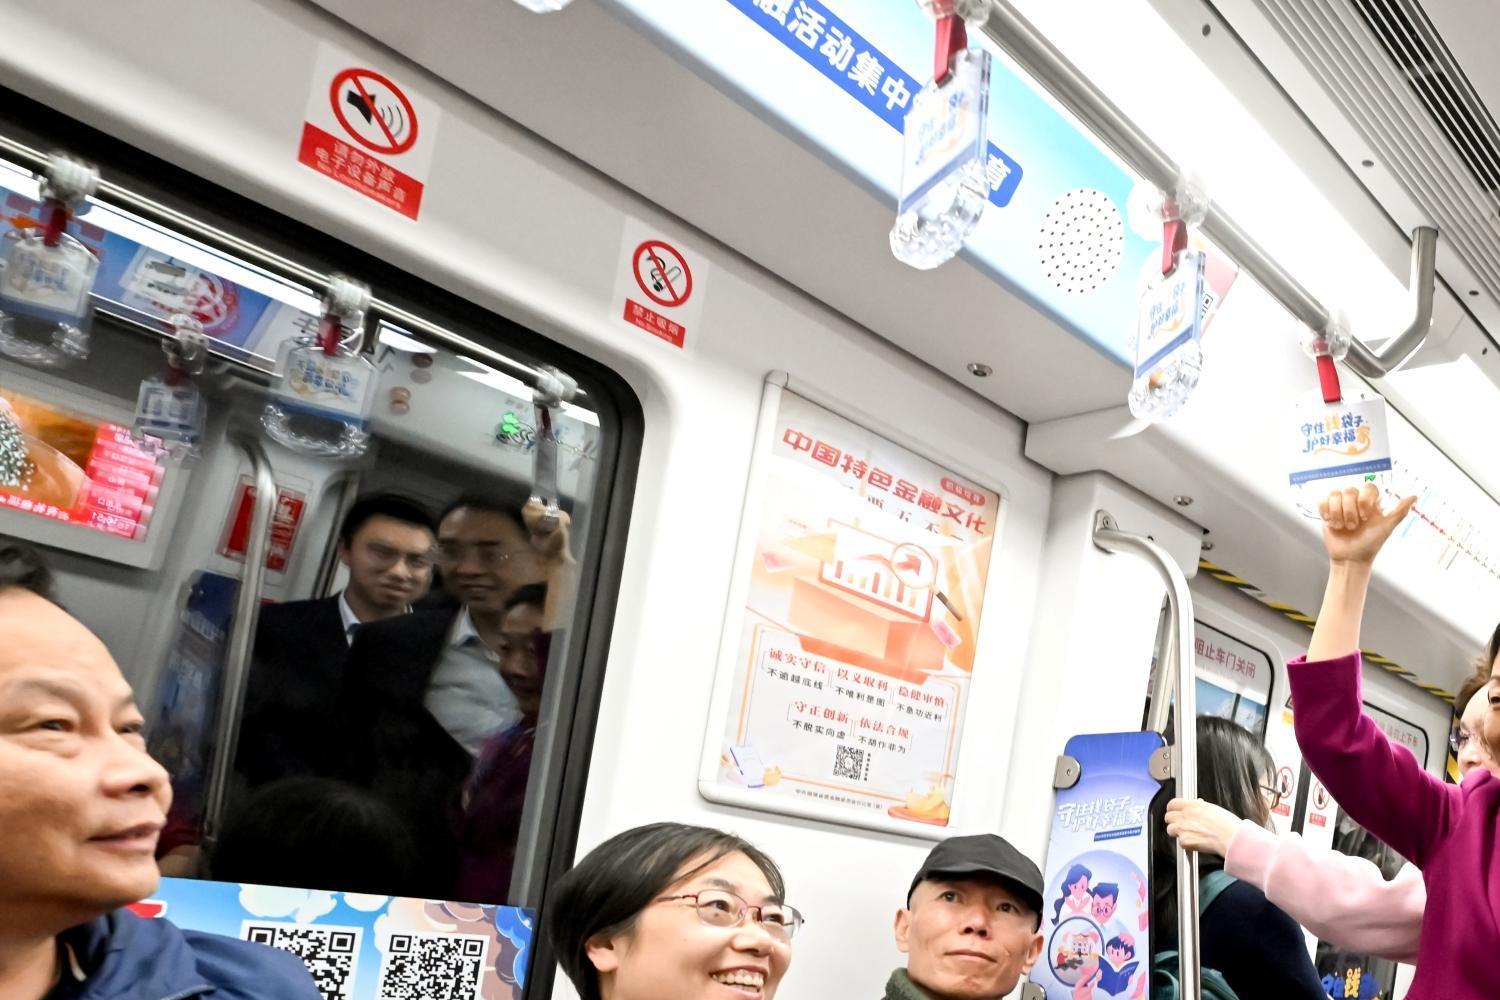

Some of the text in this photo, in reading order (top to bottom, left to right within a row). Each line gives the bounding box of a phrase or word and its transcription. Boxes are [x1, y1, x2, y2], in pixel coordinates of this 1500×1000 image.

[782, 427, 987, 535] 中国特色金融文化
[769, 647, 826, 675] 诚实守信
[837, 666, 889, 692] 以义取利
[794, 700, 849, 725] 守正创新
[859, 717, 910, 740] 依法合规
